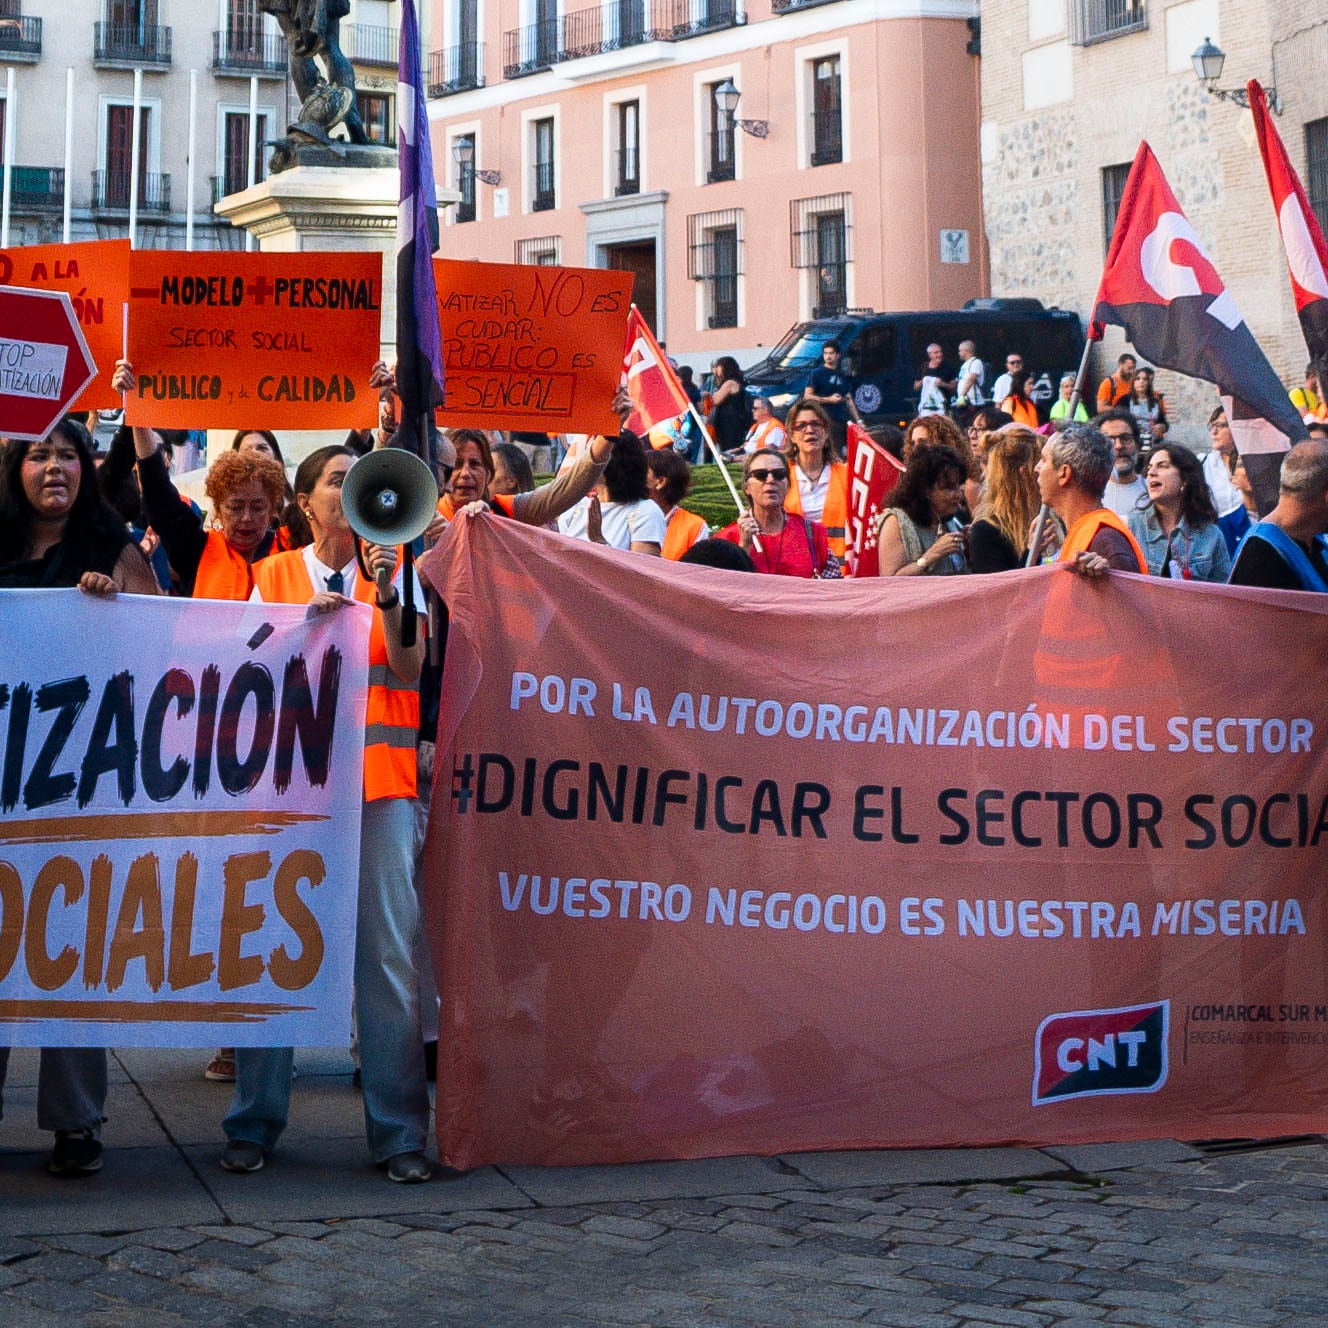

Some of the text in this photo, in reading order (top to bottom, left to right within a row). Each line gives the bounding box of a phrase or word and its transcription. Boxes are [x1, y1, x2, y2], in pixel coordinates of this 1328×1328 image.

[30, 262, 48, 281] A
[54, 260, 80, 279] LA
[161, 276, 245, 306] MODELO
[274, 277, 379, 310] PERSONAL
[435, 271, 622, 317] VATIZAR NO ES
[166, 327, 313, 353] SECTOR SOCIAL
[572, 352, 596, 368] ES
[138, 369, 222, 401] PÚBLICO
[257, 374, 356, 403] CALIDAD
[443, 373, 568, 412] ESENCIAL
[510, 671, 1314, 754] POR LA AUTOORGANIZACIÓN DEL SECTOR
[852, 783, 921, 846] EL
[937, 787, 1164, 850] SECTOR
[498, 871, 1307, 939] VUESTRO NEGOCIO ES NUESTRA MISERIA
[1191, 1004, 1273, 1022] COMARCAL
[1278, 1004, 1311, 1022] SUR
[1056, 1030, 1147, 1072] CNT
